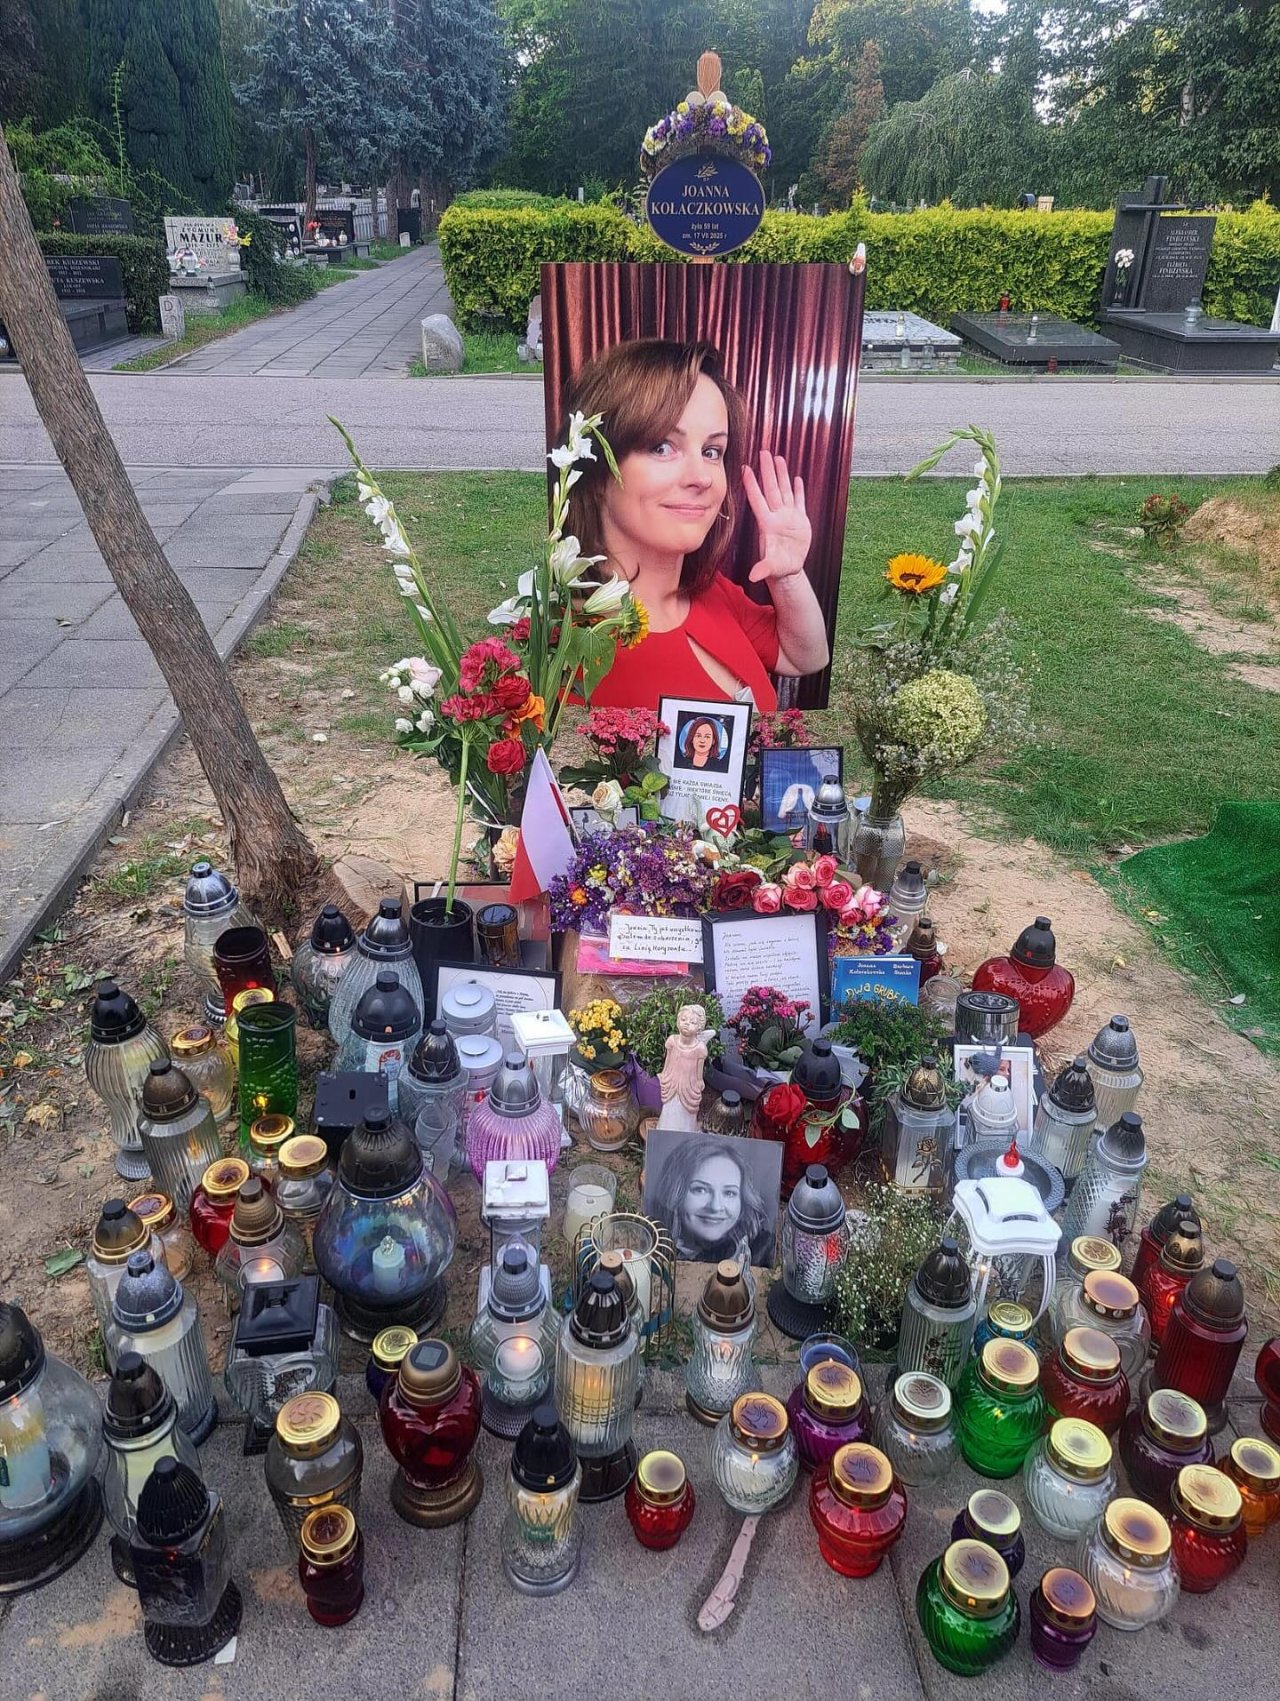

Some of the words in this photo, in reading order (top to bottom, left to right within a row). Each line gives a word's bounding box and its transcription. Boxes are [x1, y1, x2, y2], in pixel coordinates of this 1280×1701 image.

[682, 185, 729, 197] JOANNA
[180, 233, 223, 243] MAZUR
[164, 301, 173, 311] D
